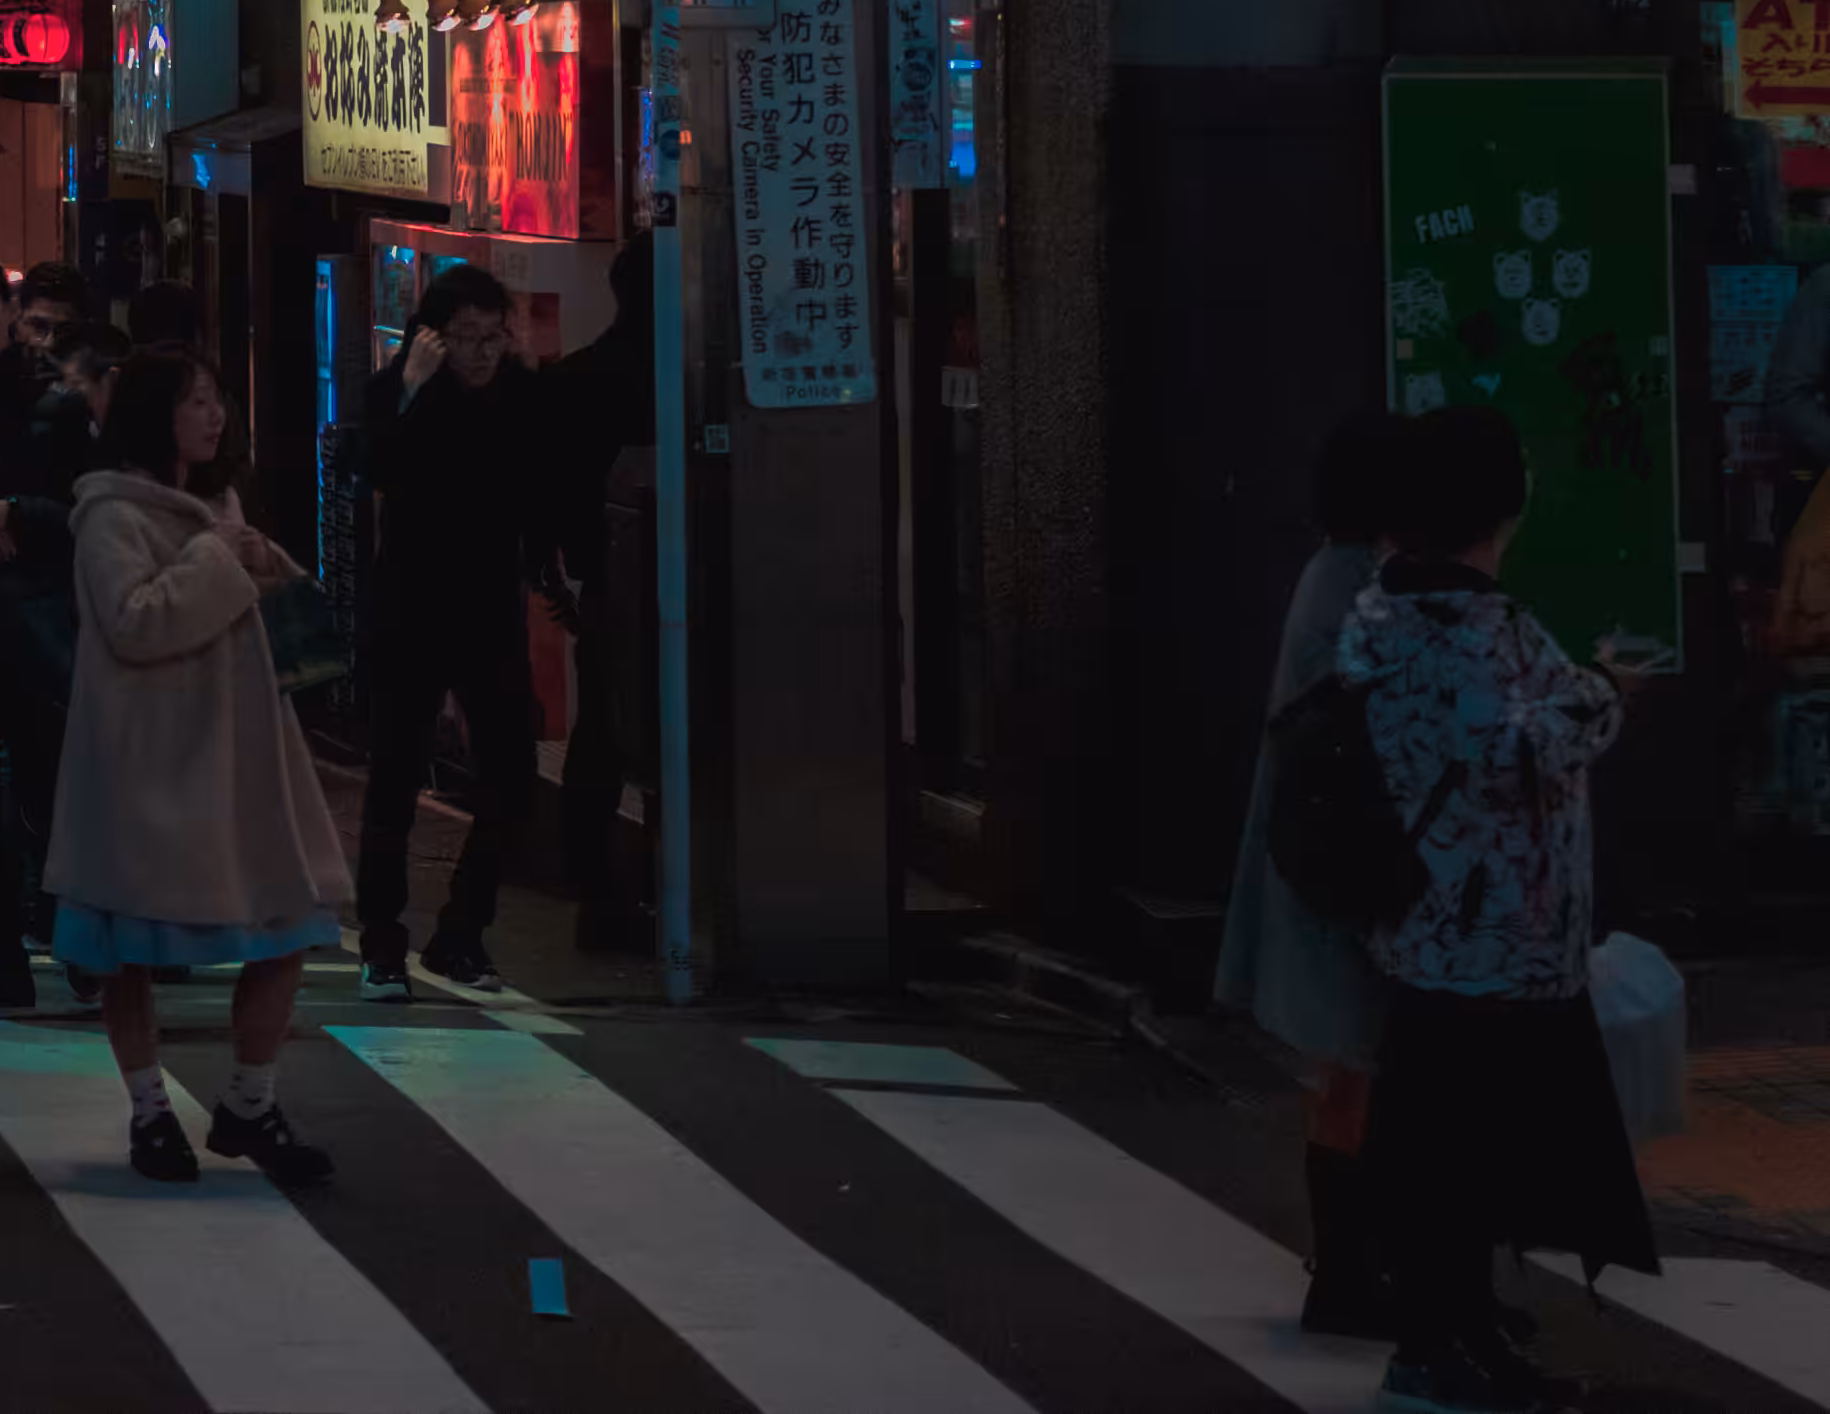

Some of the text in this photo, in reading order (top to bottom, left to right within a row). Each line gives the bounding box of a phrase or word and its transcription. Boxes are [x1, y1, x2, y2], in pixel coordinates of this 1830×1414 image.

[733, 49, 768, 356] Security Camera in Operation
[757, 53, 782, 173] Your Safety
[780, 11, 827, 333] 防犯カメラ作動中
